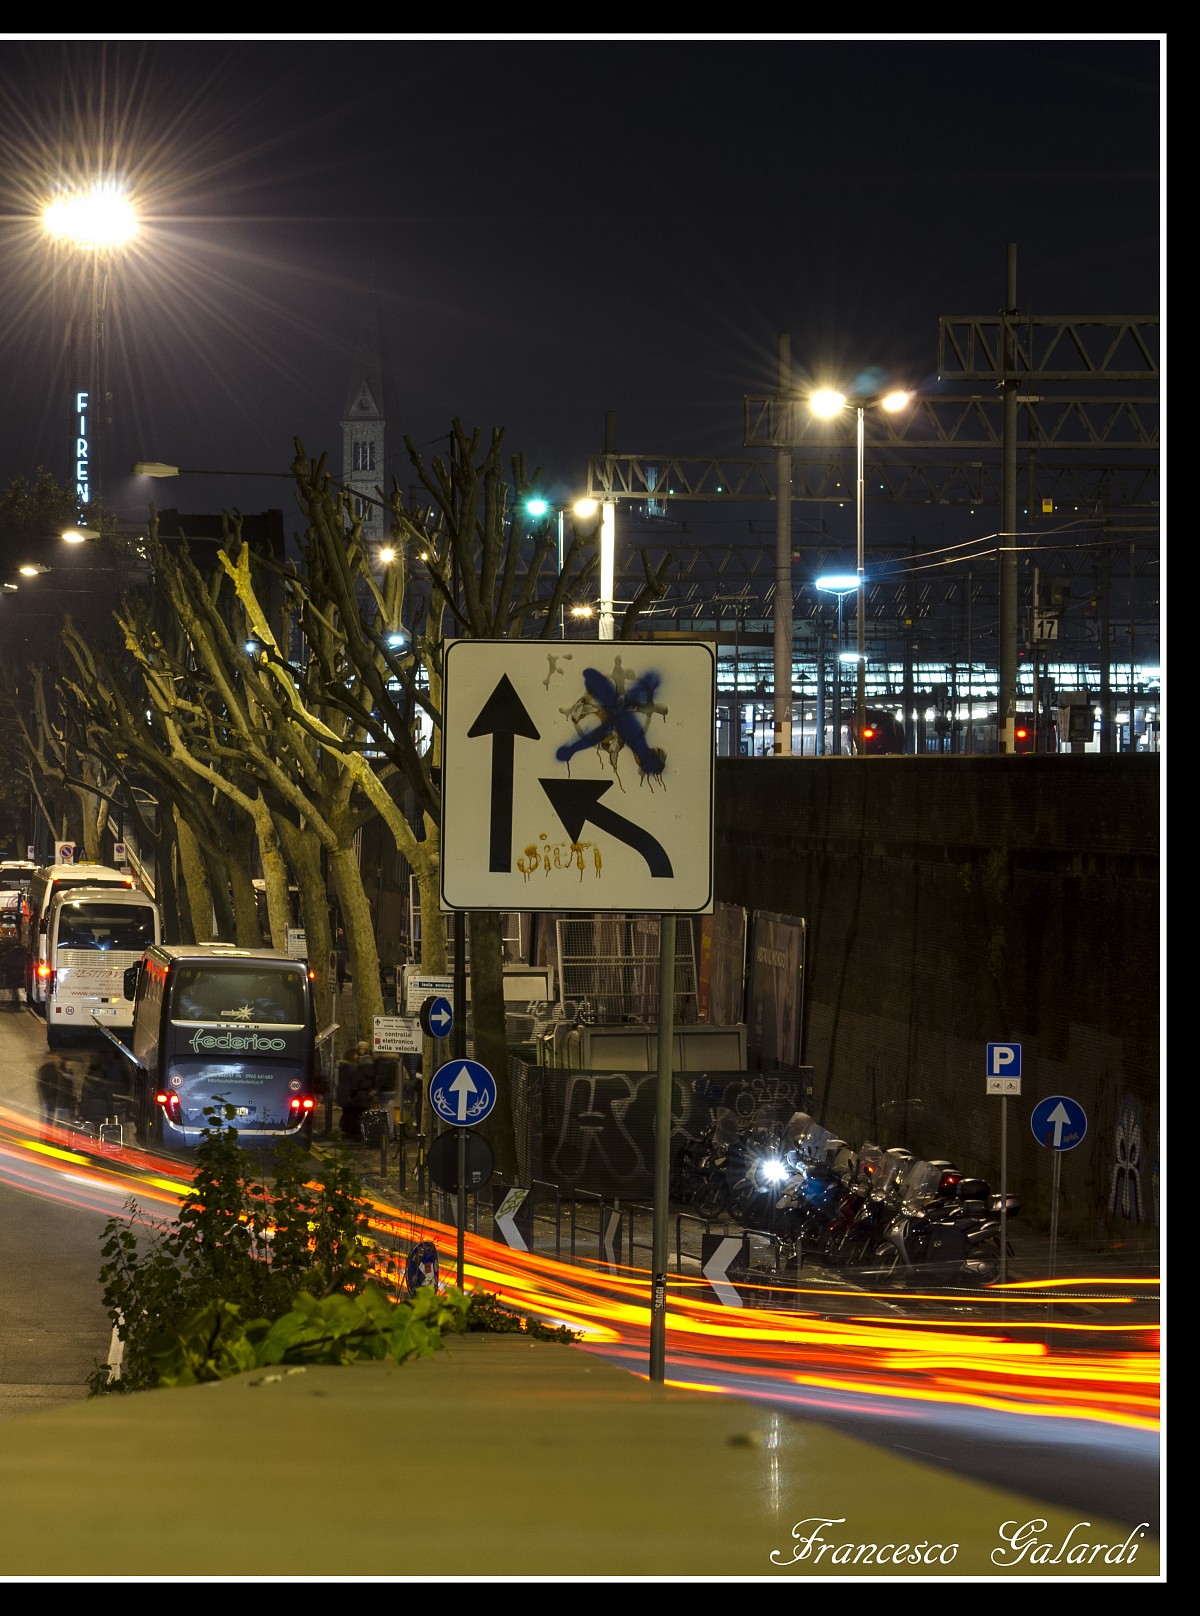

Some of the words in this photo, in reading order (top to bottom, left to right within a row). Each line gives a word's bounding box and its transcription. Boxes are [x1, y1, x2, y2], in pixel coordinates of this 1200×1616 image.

[76, 392, 89, 525] FIREN
[1037, 620, 1055, 638] 17
[188, 1028, 287, 1053] federico
[382, 1037, 414, 1045] elettronico
[993, 1046, 1015, 1074] P
